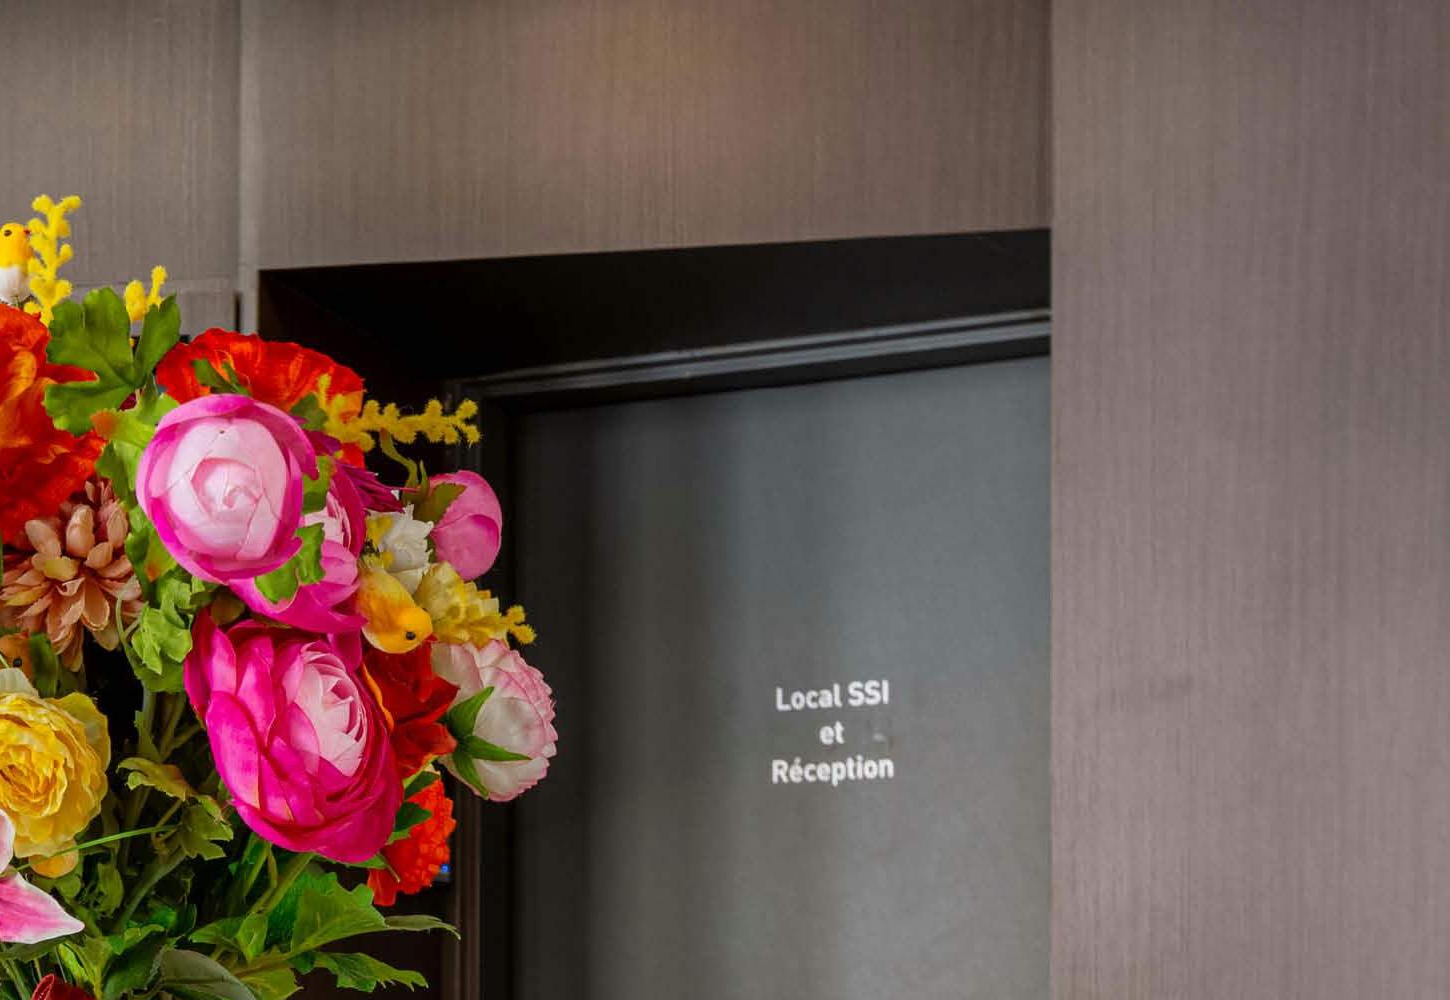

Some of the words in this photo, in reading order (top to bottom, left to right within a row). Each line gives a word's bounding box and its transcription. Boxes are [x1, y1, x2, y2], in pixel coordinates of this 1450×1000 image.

[776, 683, 842, 711] Local
[848, 680, 890, 707] SSI
[819, 721, 845, 745] et
[772, 754, 894, 787] Réception
